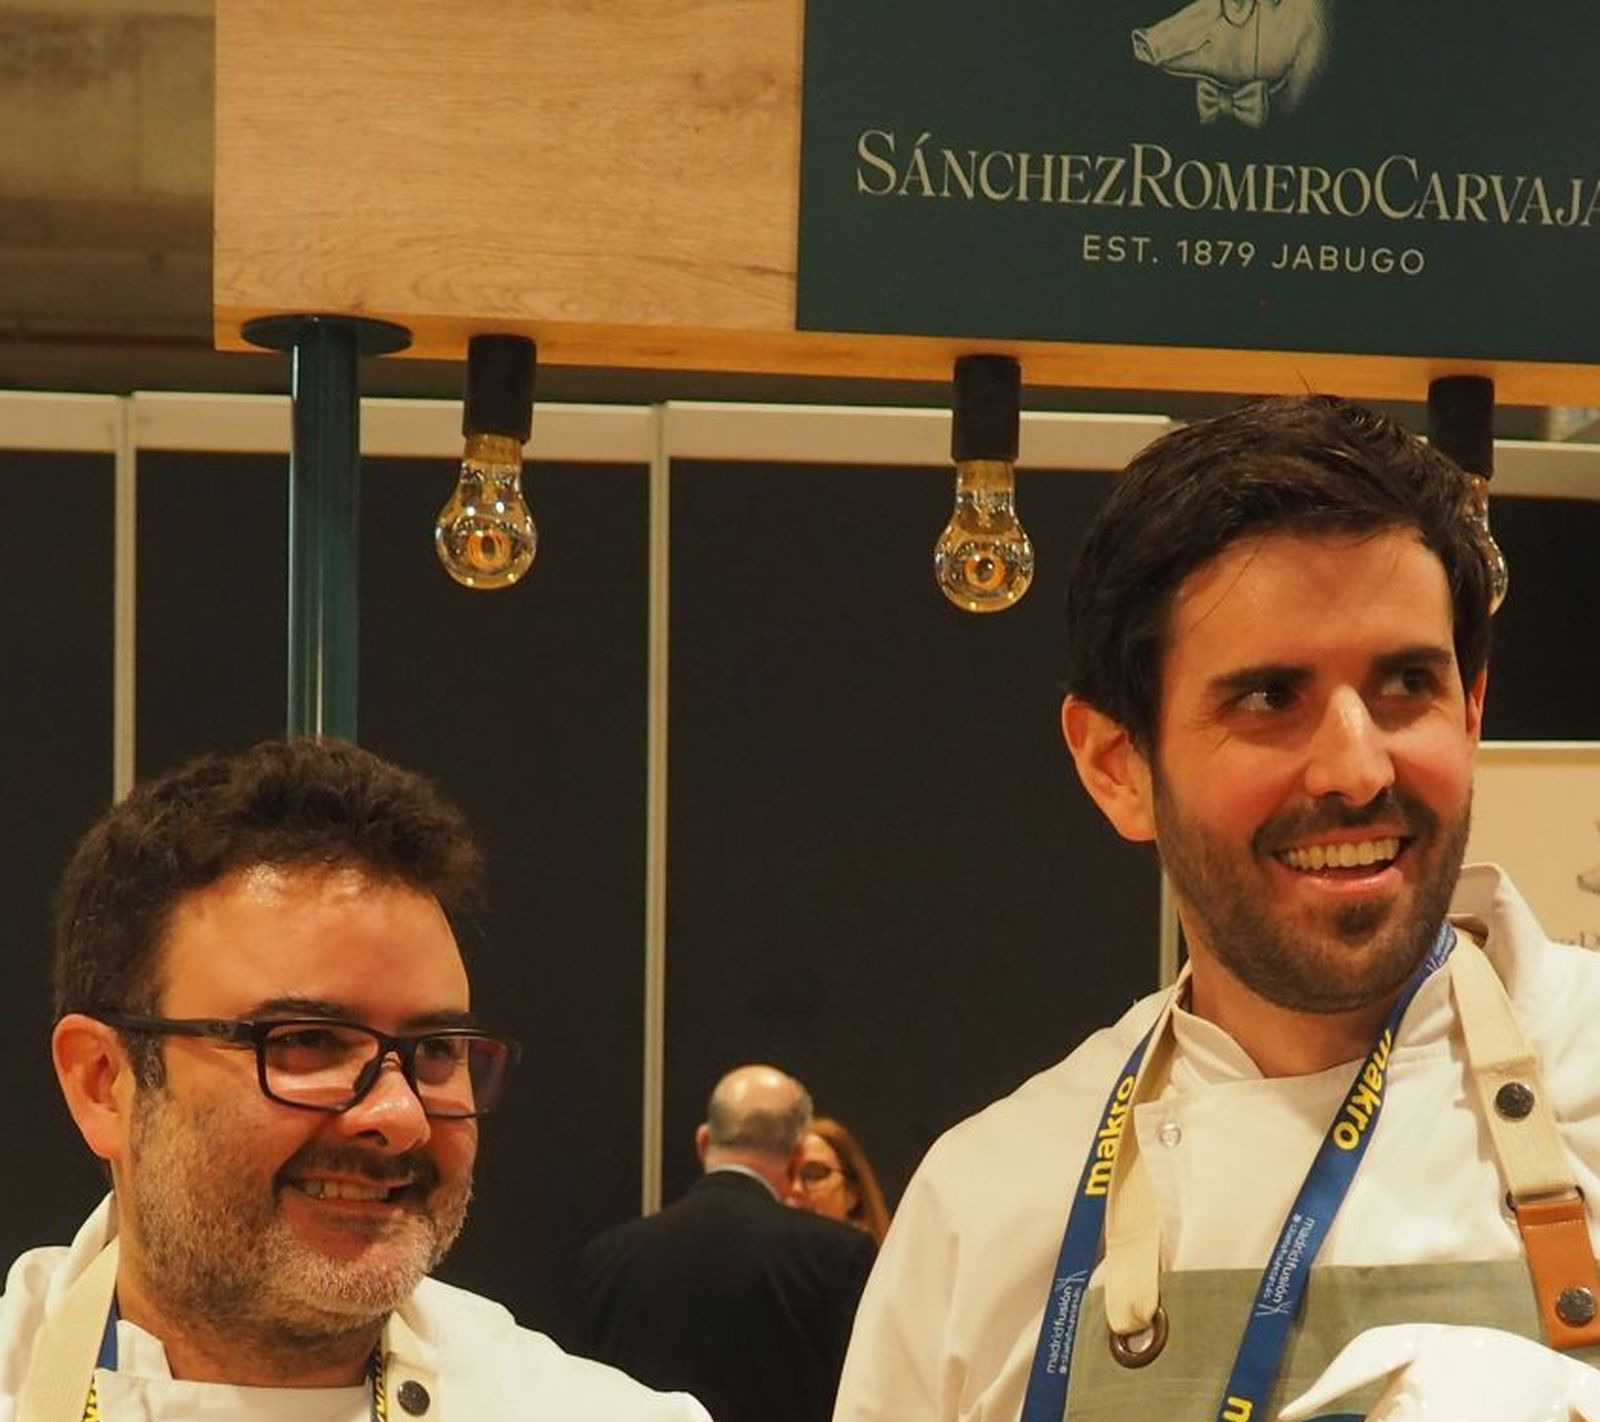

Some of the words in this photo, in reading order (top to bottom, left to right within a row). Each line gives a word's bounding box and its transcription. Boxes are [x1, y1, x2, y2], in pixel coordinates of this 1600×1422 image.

[1083, 234, 1158, 264] EST.
[1176, 239, 1256, 269] 1879
[1271, 242, 1426, 275] JABUGO
[1085, 1075, 1135, 1195] makro
[1333, 1028, 1392, 1150] makro
